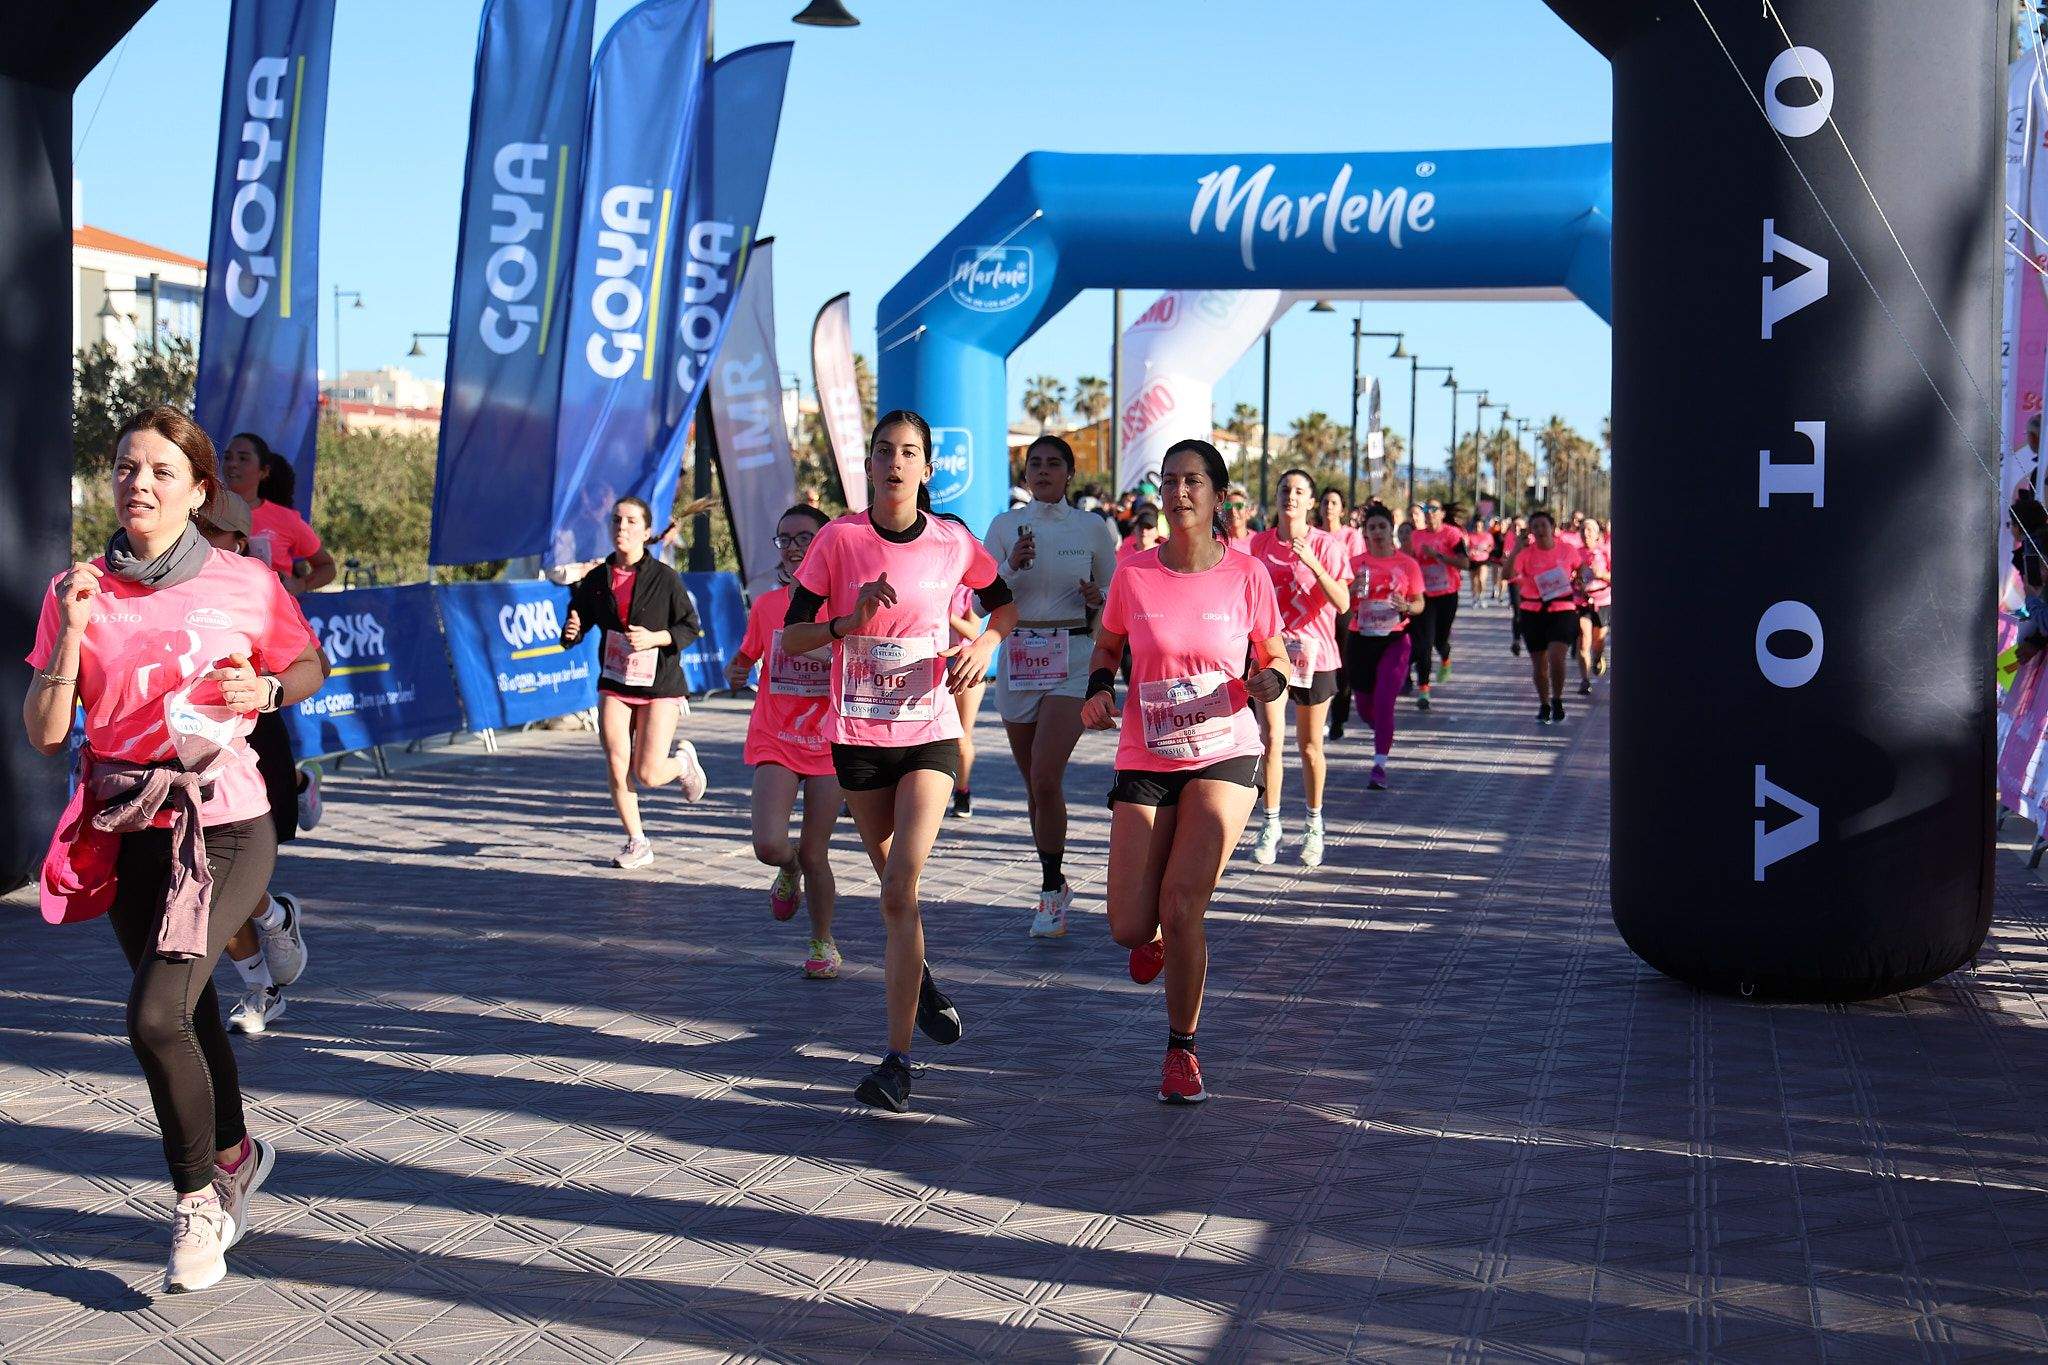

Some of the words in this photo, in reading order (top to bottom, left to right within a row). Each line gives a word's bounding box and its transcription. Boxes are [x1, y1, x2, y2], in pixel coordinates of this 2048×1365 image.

[226, 56, 289, 318] GOYA
[1190, 162, 1436, 272] Marlene
[479, 141, 549, 355] GOYA
[586, 185, 654, 379] GOYA
[722, 353, 775, 470] IMR
[1755, 45, 1834, 881] VOLVO
[499, 599, 562, 649] GOYA
[793, 661, 819, 672] 016
[873, 674, 907, 689] 016
[1026, 657, 1050, 667] 016
[851, 705, 880, 714] OYSHO
[1174, 711, 1206, 727] 016
[1157, 746, 1185, 755] OYSHO
